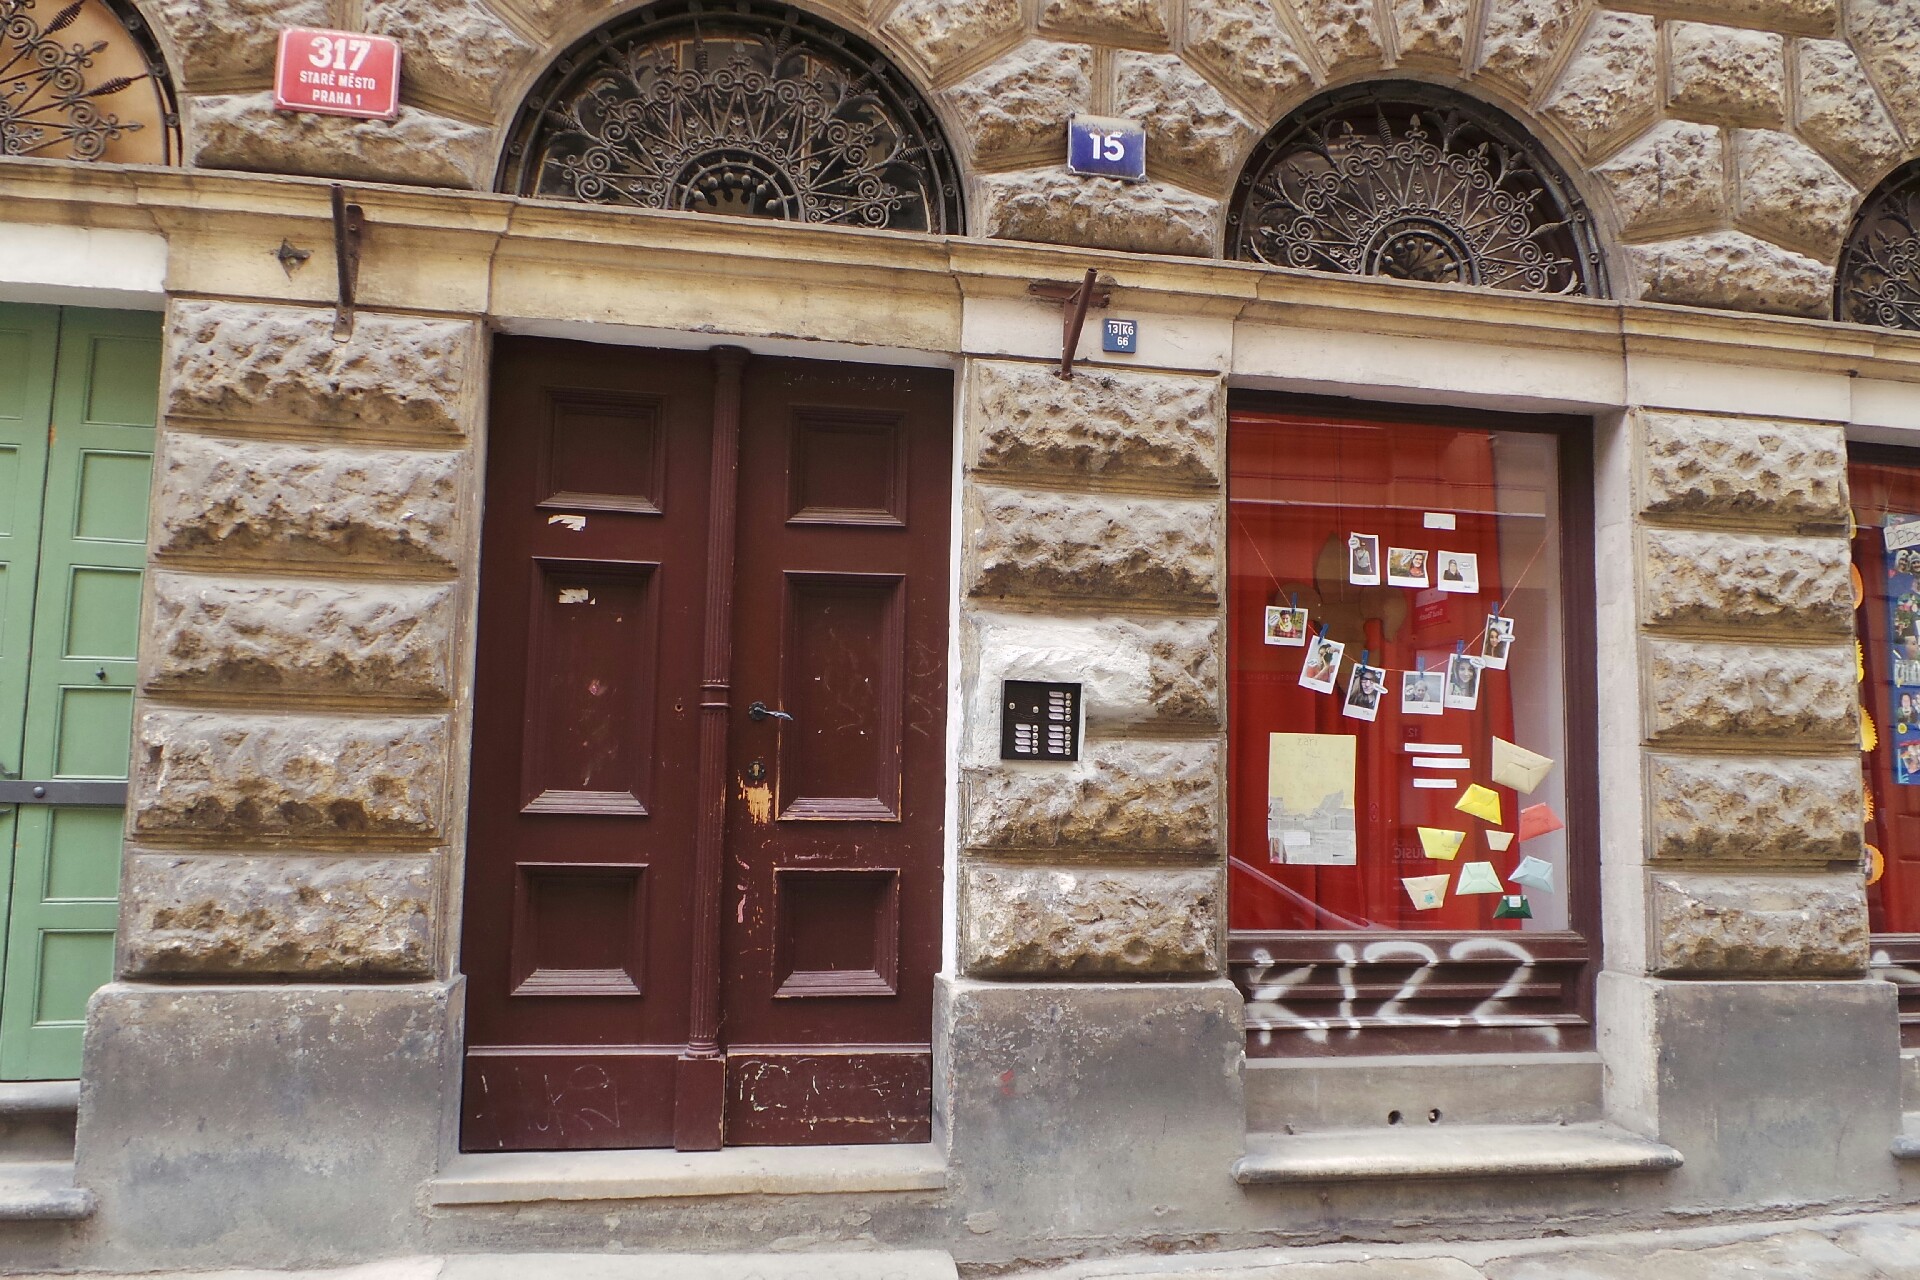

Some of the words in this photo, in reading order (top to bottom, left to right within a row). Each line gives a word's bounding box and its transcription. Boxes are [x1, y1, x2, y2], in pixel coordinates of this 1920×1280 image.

[309, 37, 371, 71] 317
[299, 70, 335, 86] STARÉ
[338, 73, 376, 90] MĚSTO
[312, 89, 352, 105] PRAHA
[355, 94, 361, 106] 1
[1089, 132, 1125, 162] 15
[1117, 336, 1129, 346] 66
